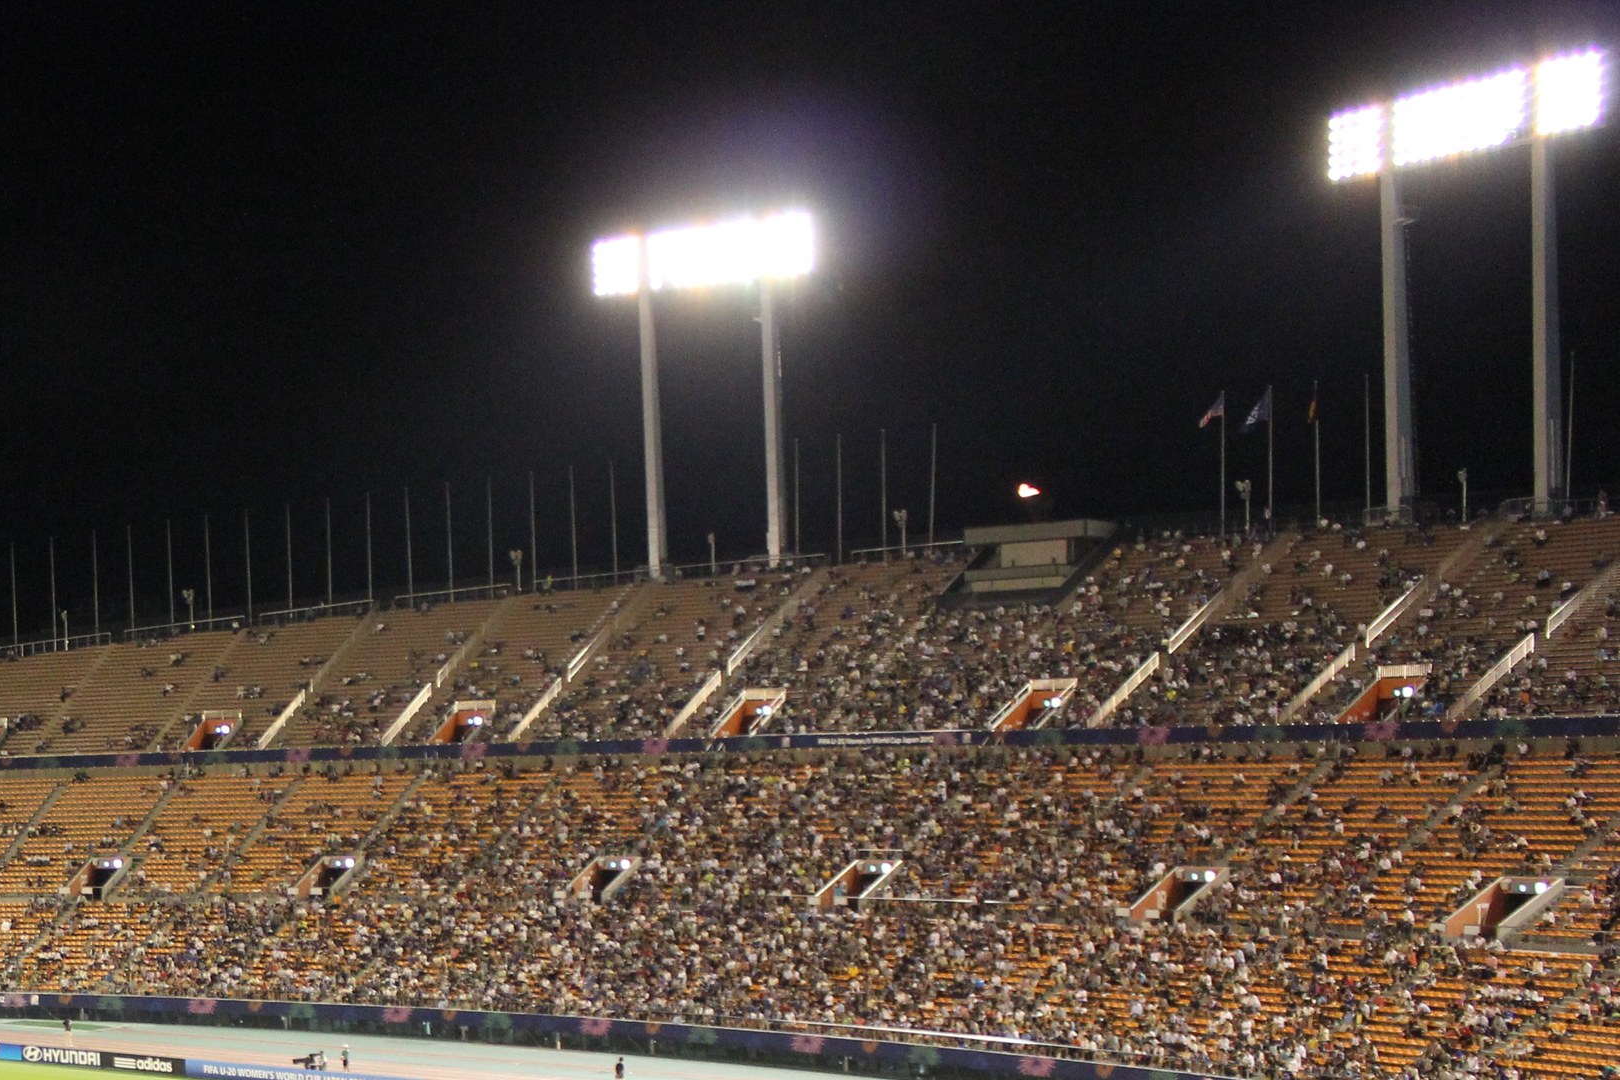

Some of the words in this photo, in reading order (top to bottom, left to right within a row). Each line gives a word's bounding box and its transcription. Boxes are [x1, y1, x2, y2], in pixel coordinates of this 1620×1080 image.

[42, 1048, 101, 1066] HYUNDAI
[136, 1057, 173, 1073] adidas
[203, 1065, 219, 1075] FIFA
[219, 1066, 237, 1077] U-20
[238, 1068, 275, 1080] WOMEN'S
